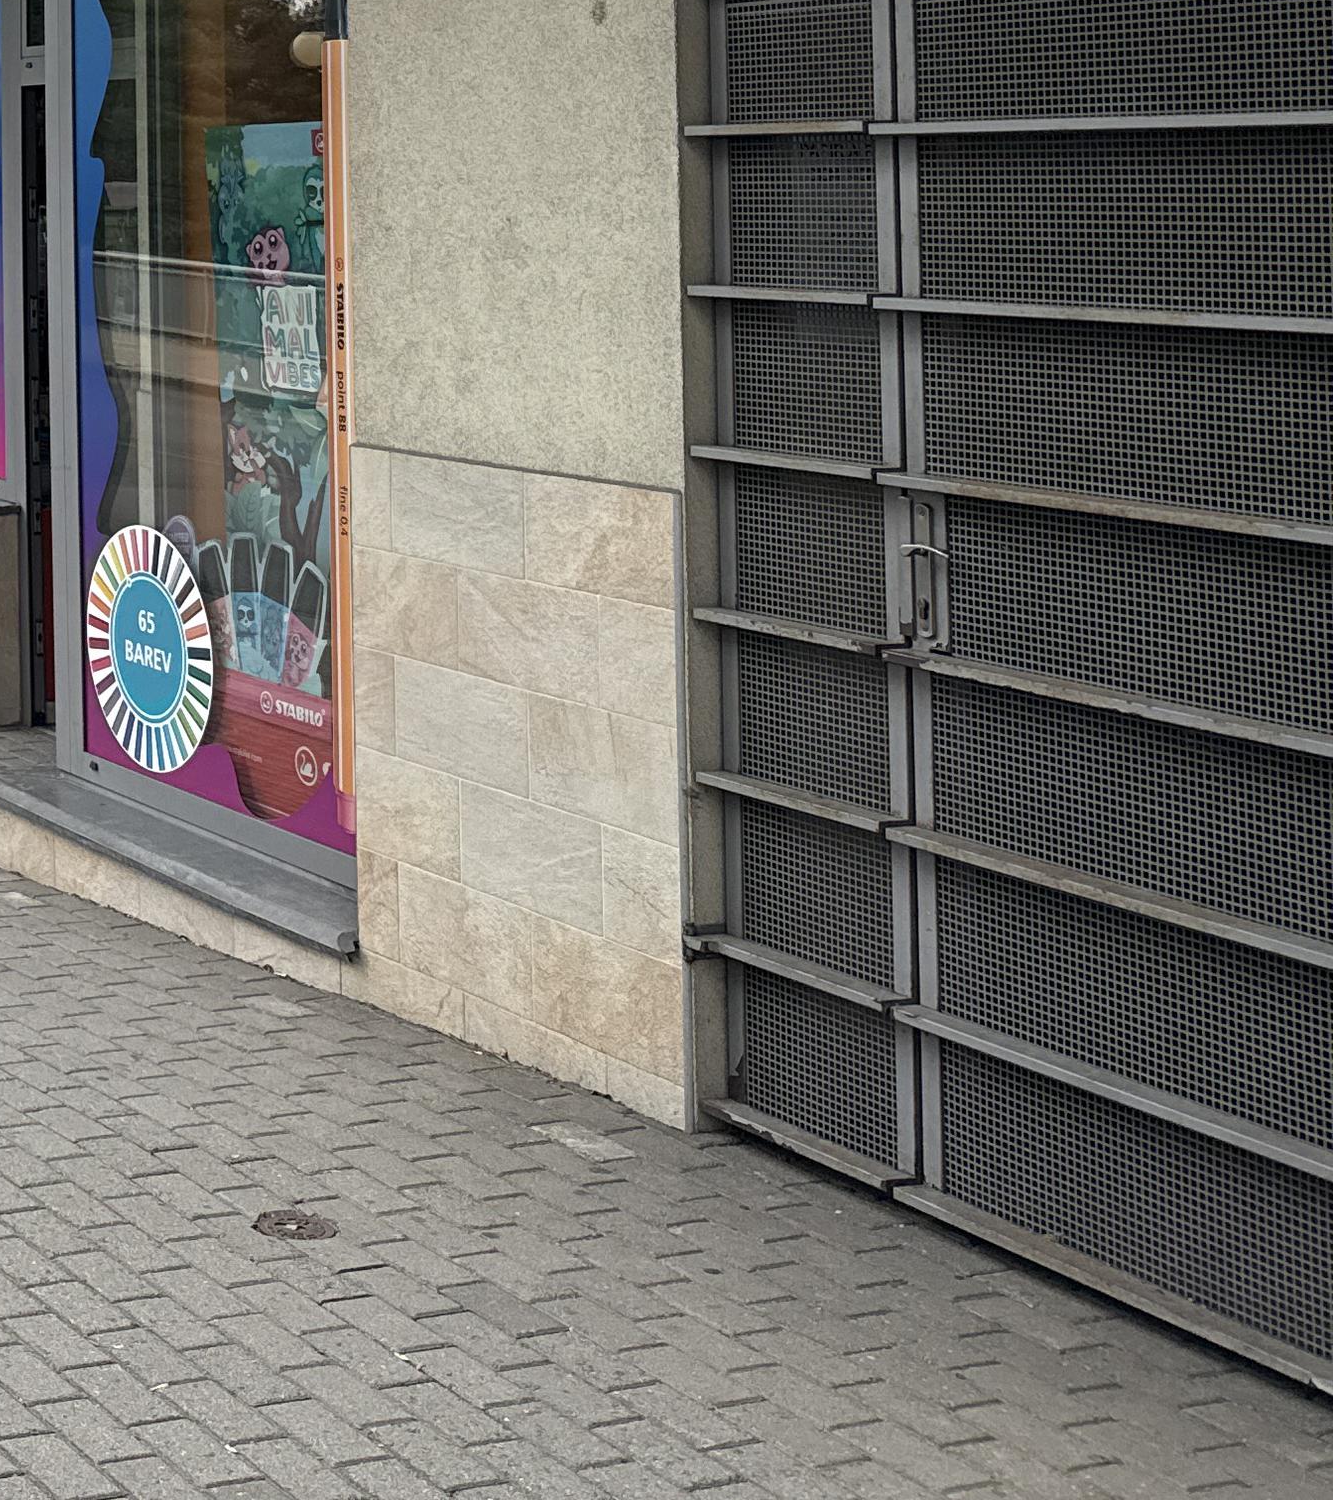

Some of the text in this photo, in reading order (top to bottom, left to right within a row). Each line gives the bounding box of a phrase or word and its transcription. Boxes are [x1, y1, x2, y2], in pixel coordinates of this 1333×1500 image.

[266, 289, 314, 326] ANI
[336, 282, 345, 350] STABILO
[265, 325, 319, 361] MAL
[265, 361, 321, 390] VIBES
[336, 371, 346, 411] point
[339, 485, 348, 511] fine
[137, 610, 156, 634] 65
[124, 639, 172, 674] BAREV
[275, 699, 323, 728] STABILO
